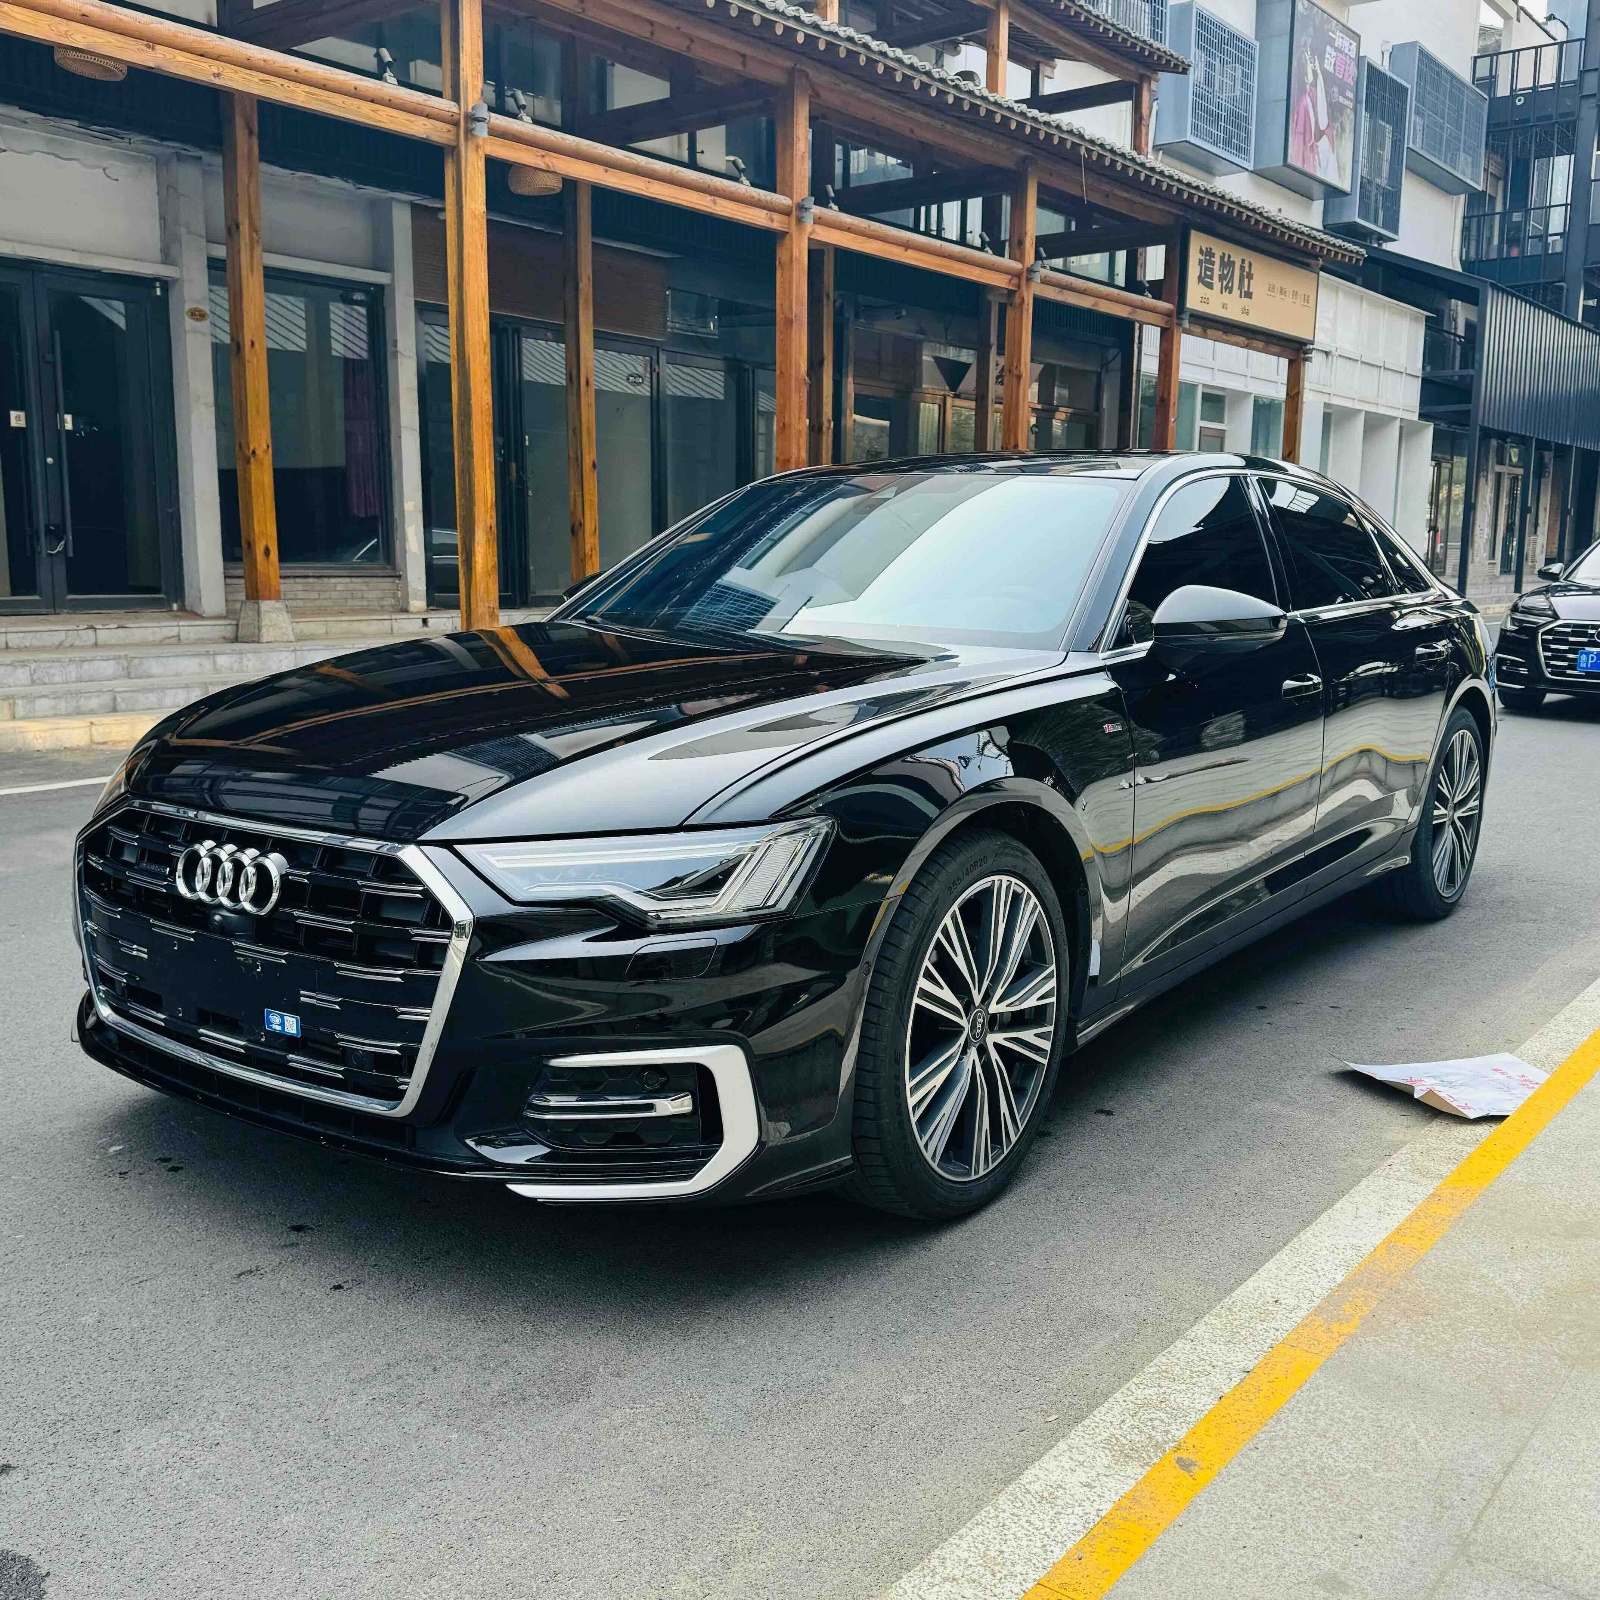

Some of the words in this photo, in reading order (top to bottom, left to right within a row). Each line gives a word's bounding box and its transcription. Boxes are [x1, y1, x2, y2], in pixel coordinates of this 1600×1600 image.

[1198, 245, 1254, 300] 造物社
[947, 855, 989, 895] 255/40R20
